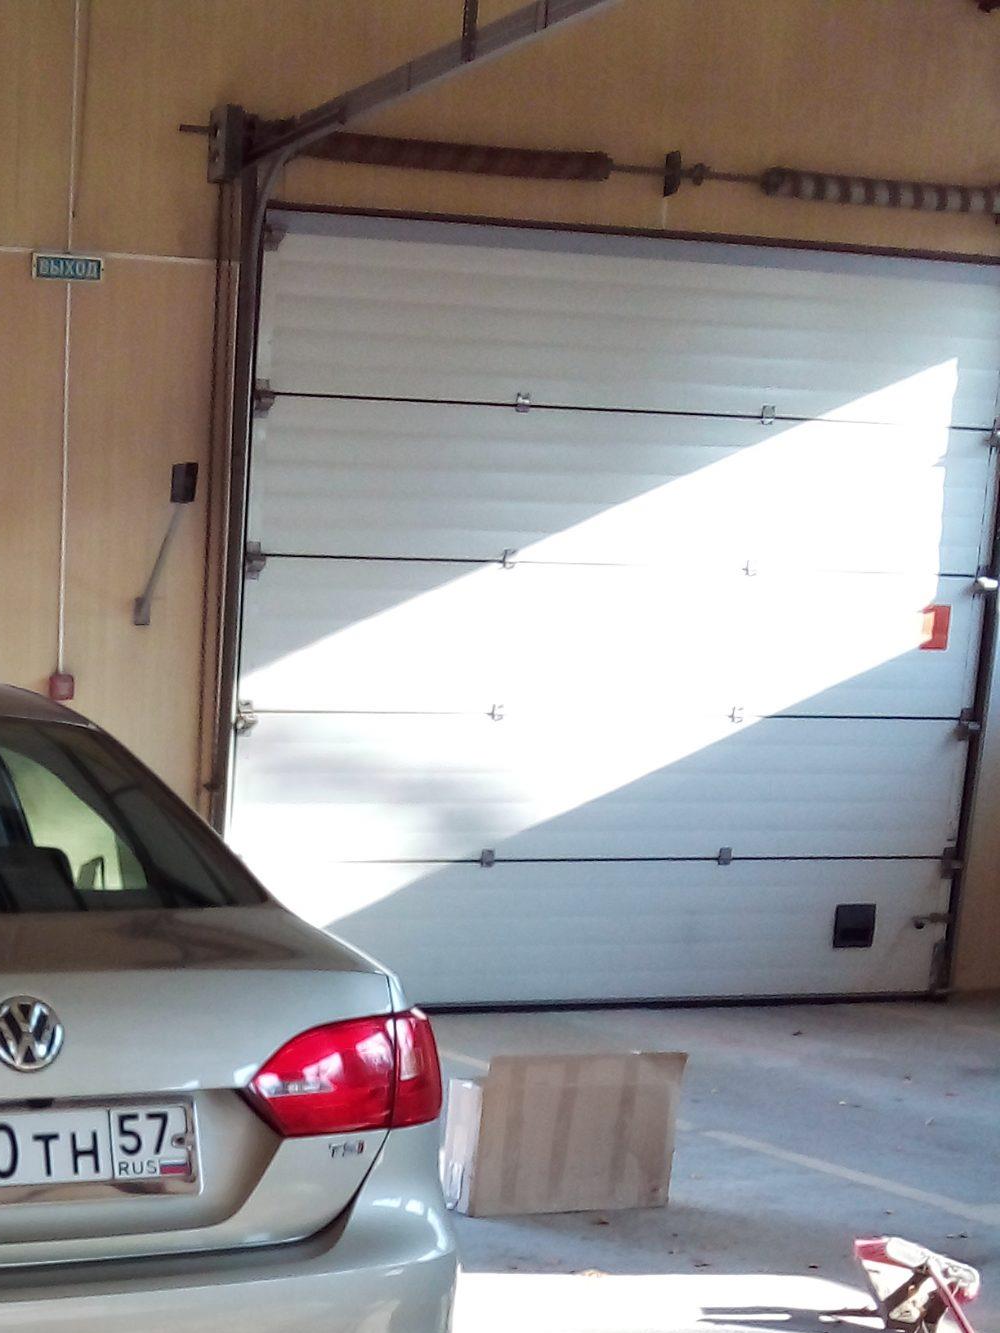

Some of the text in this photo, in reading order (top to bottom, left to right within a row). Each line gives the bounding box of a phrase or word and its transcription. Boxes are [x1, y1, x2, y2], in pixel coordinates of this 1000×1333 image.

[39, 259, 98, 277] ВЫХОД
[118, 1112, 168, 1155] 57
[117, 1159, 158, 1176] RUS
